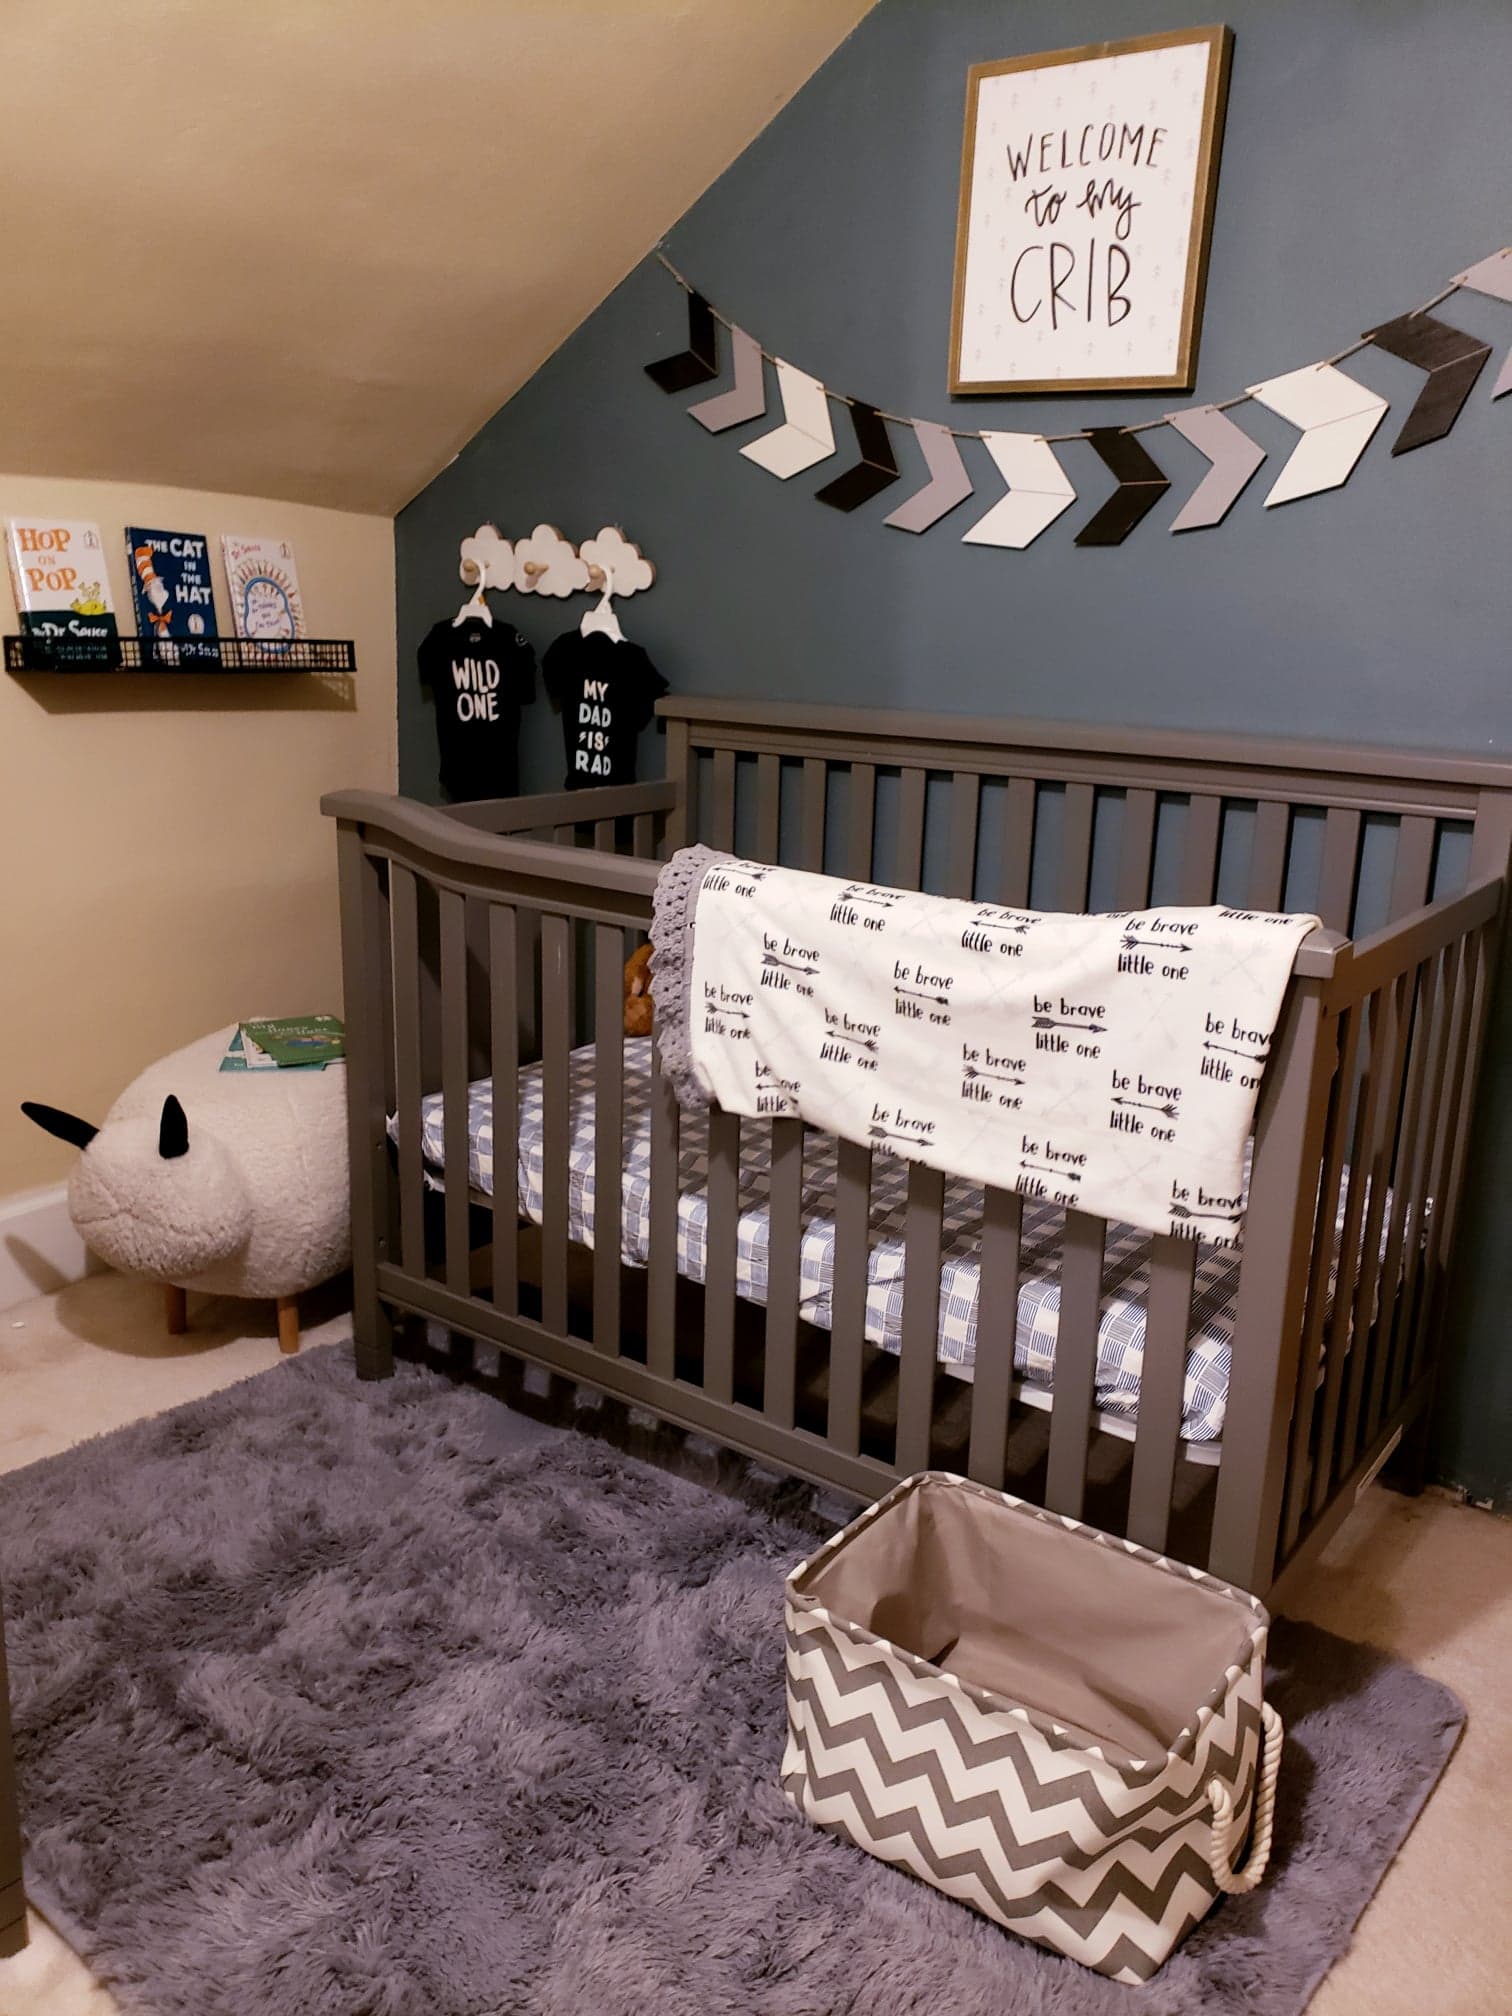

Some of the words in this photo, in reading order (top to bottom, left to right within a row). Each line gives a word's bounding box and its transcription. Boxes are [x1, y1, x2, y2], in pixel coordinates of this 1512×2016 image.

[1006, 122, 1169, 182] WELCOME
[1024, 184, 1068, 228] to
[1075, 177, 1142, 241] my
[1010, 237, 1132, 331] CRIB
[17, 528, 71, 552] HOP
[144, 538, 168, 553] THE
[169, 538, 204, 558] CAT
[181, 572, 202, 585] THE
[183, 560, 196, 572] IN
[25, 567, 77, 592] POP
[175, 584, 211, 605] HAT
[452, 657, 500, 694] WILD
[583, 679, 609, 702] MY
[456, 692, 500, 722] ONE
[578, 703, 612, 728] DAD
[586, 731, 604, 751] IS
[575, 750, 612, 776] RAD
[702, 873, 730, 892] little
[735, 883, 757, 898] one
[830, 902, 859, 926] little
[863, 916, 886, 932] one
[976, 907, 997, 917] be
[1000, 910, 1043, 925] brave
[1125, 917, 1147, 931] be
[1151, 917, 1199, 935] brave
[763, 931, 778, 952] be
[783, 937, 821, 963] brave
[961, 929, 993, 953] little
[1000, 942, 1024, 957] one
[893, 960, 911, 981] be
[915, 964, 954, 991] brave
[1117, 953, 1155, 975] little
[1161, 964, 1189, 980] one
[761, 968, 792, 992] little
[704, 981, 717, 999] be
[720, 990, 754, 1006] brave
[1033, 994, 1052, 1013] be
[1061, 997, 1106, 1019] brave
[824, 1007, 839, 1026] be
[843, 1012, 882, 1038] brave
[895, 997, 924, 1021] little
[929, 1010, 952, 1027] one
[1205, 1012, 1225, 1034] be
[704, 1019, 726, 1035] little
[819, 1042, 852, 1065] little
[857, 1055, 878, 1073] one
[963, 1042, 980, 1062] be
[986, 1047, 1027, 1072] brave
[1035, 1031, 1070, 1054] little
[1076, 1042, 1102, 1060] one
[755, 1060, 771, 1078] be
[1200, 1056, 1234, 1083] little
[961, 1079, 993, 1103] little
[999, 1095, 1023, 1111] one
[1112, 1069, 1131, 1090] be
[1137, 1074, 1183, 1102] brave
[757, 1095, 787, 1114] little
[872, 1103, 890, 1123] be
[896, 1108, 937, 1135] brave
[1110, 1111, 1145, 1134] little
[1150, 1125, 1177, 1144] one
[1023, 1135, 1040, 1155] be
[1045, 1142, 1088, 1168] brave
[1015, 1175, 1048, 1195] little
[1172, 1179, 1190, 1201] be
